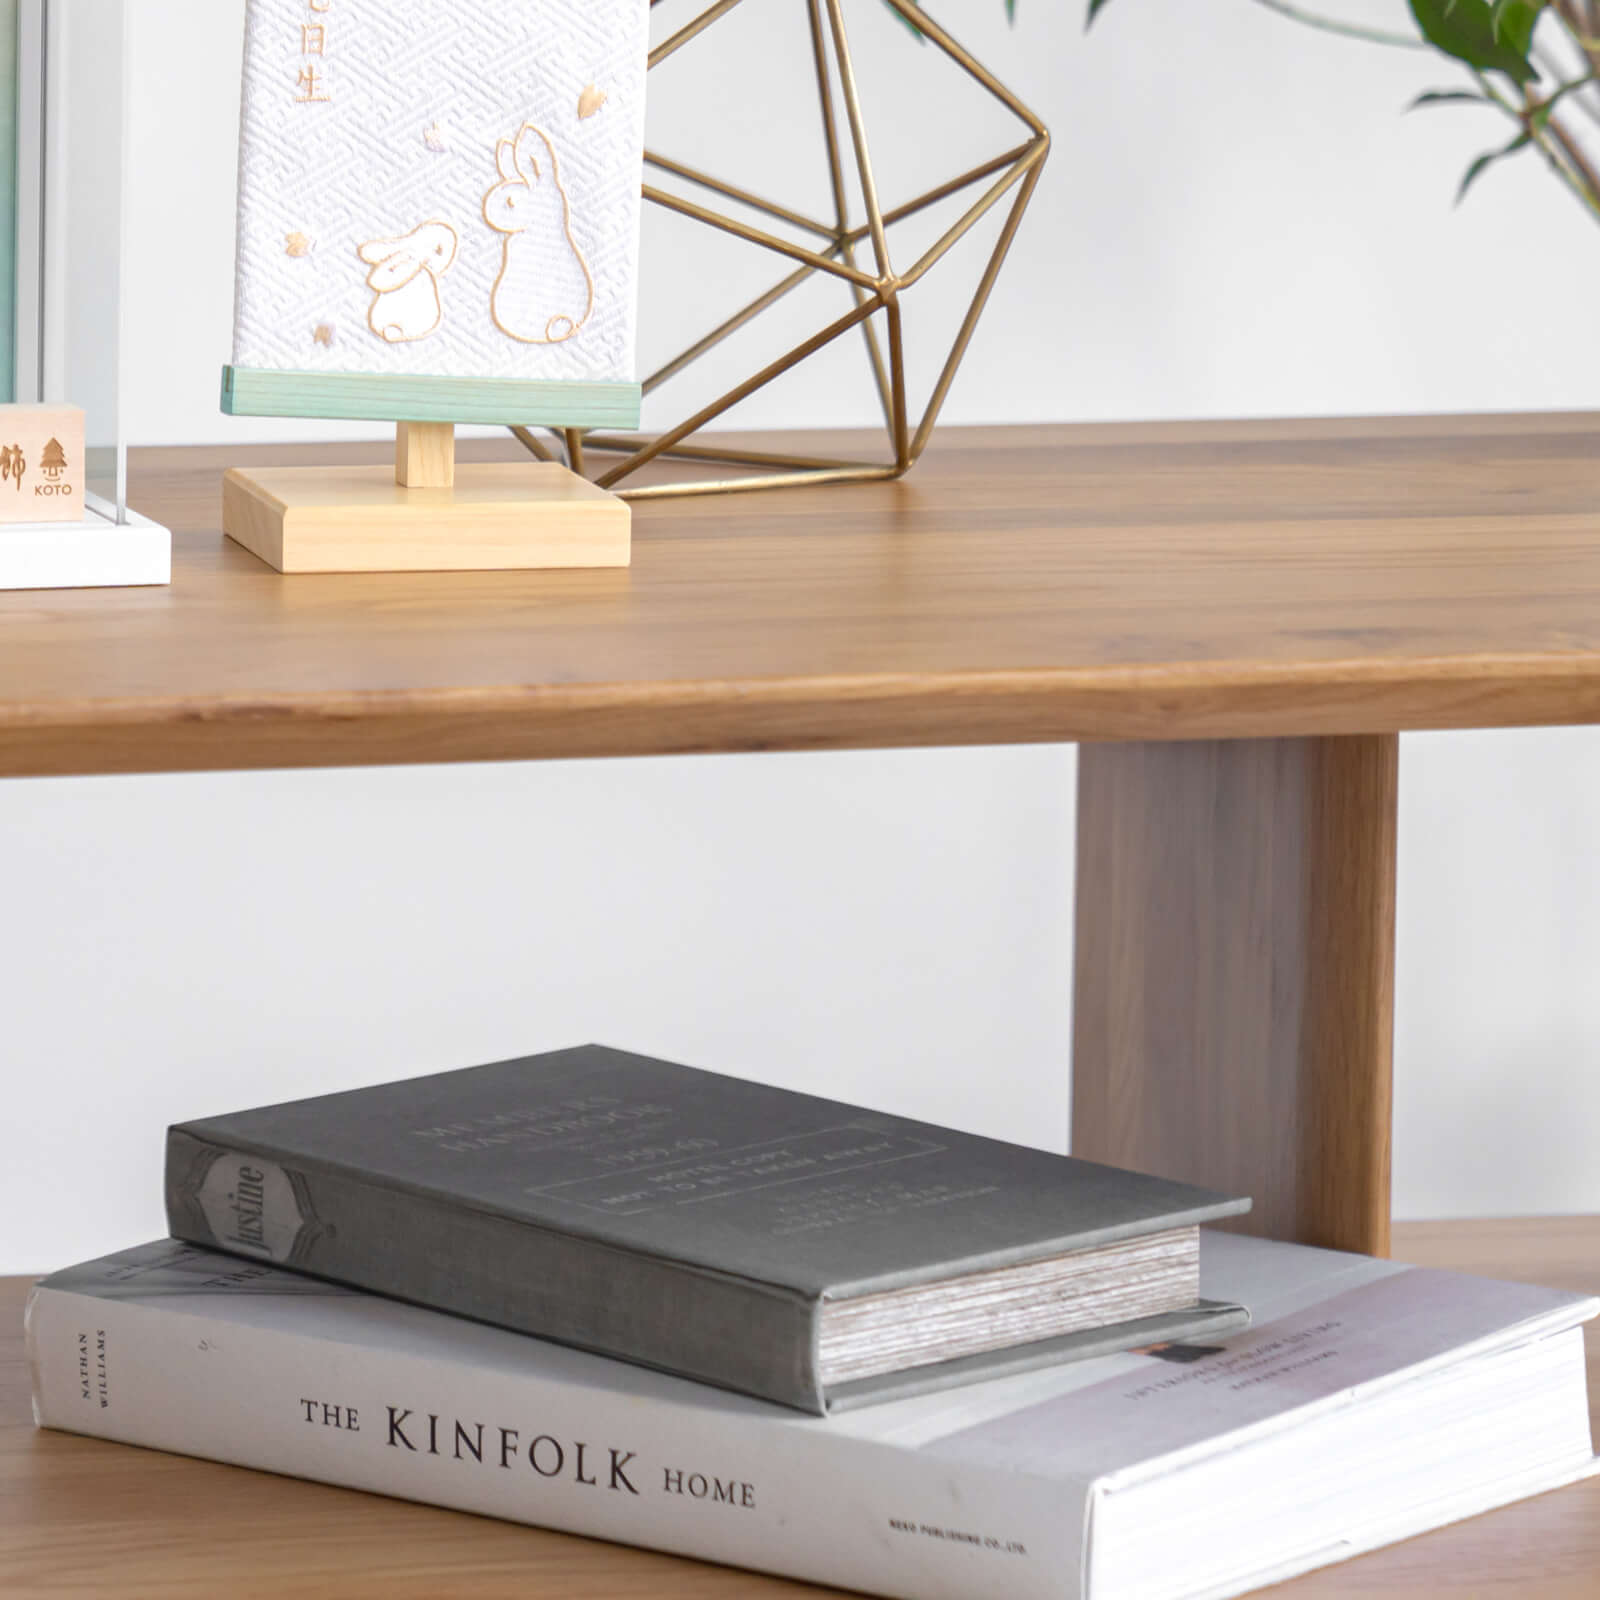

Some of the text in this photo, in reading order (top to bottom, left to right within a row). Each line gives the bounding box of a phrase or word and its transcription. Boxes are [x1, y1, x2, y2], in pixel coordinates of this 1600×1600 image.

[34, 483, 72, 497] KOTO
[227, 1166, 274, 1252] Justine
[78, 1333, 92, 1399] NATHAN
[97, 1329, 109, 1409] WILLIAMS
[301, 1399, 755, 1509] THE KINFOLK HOME
